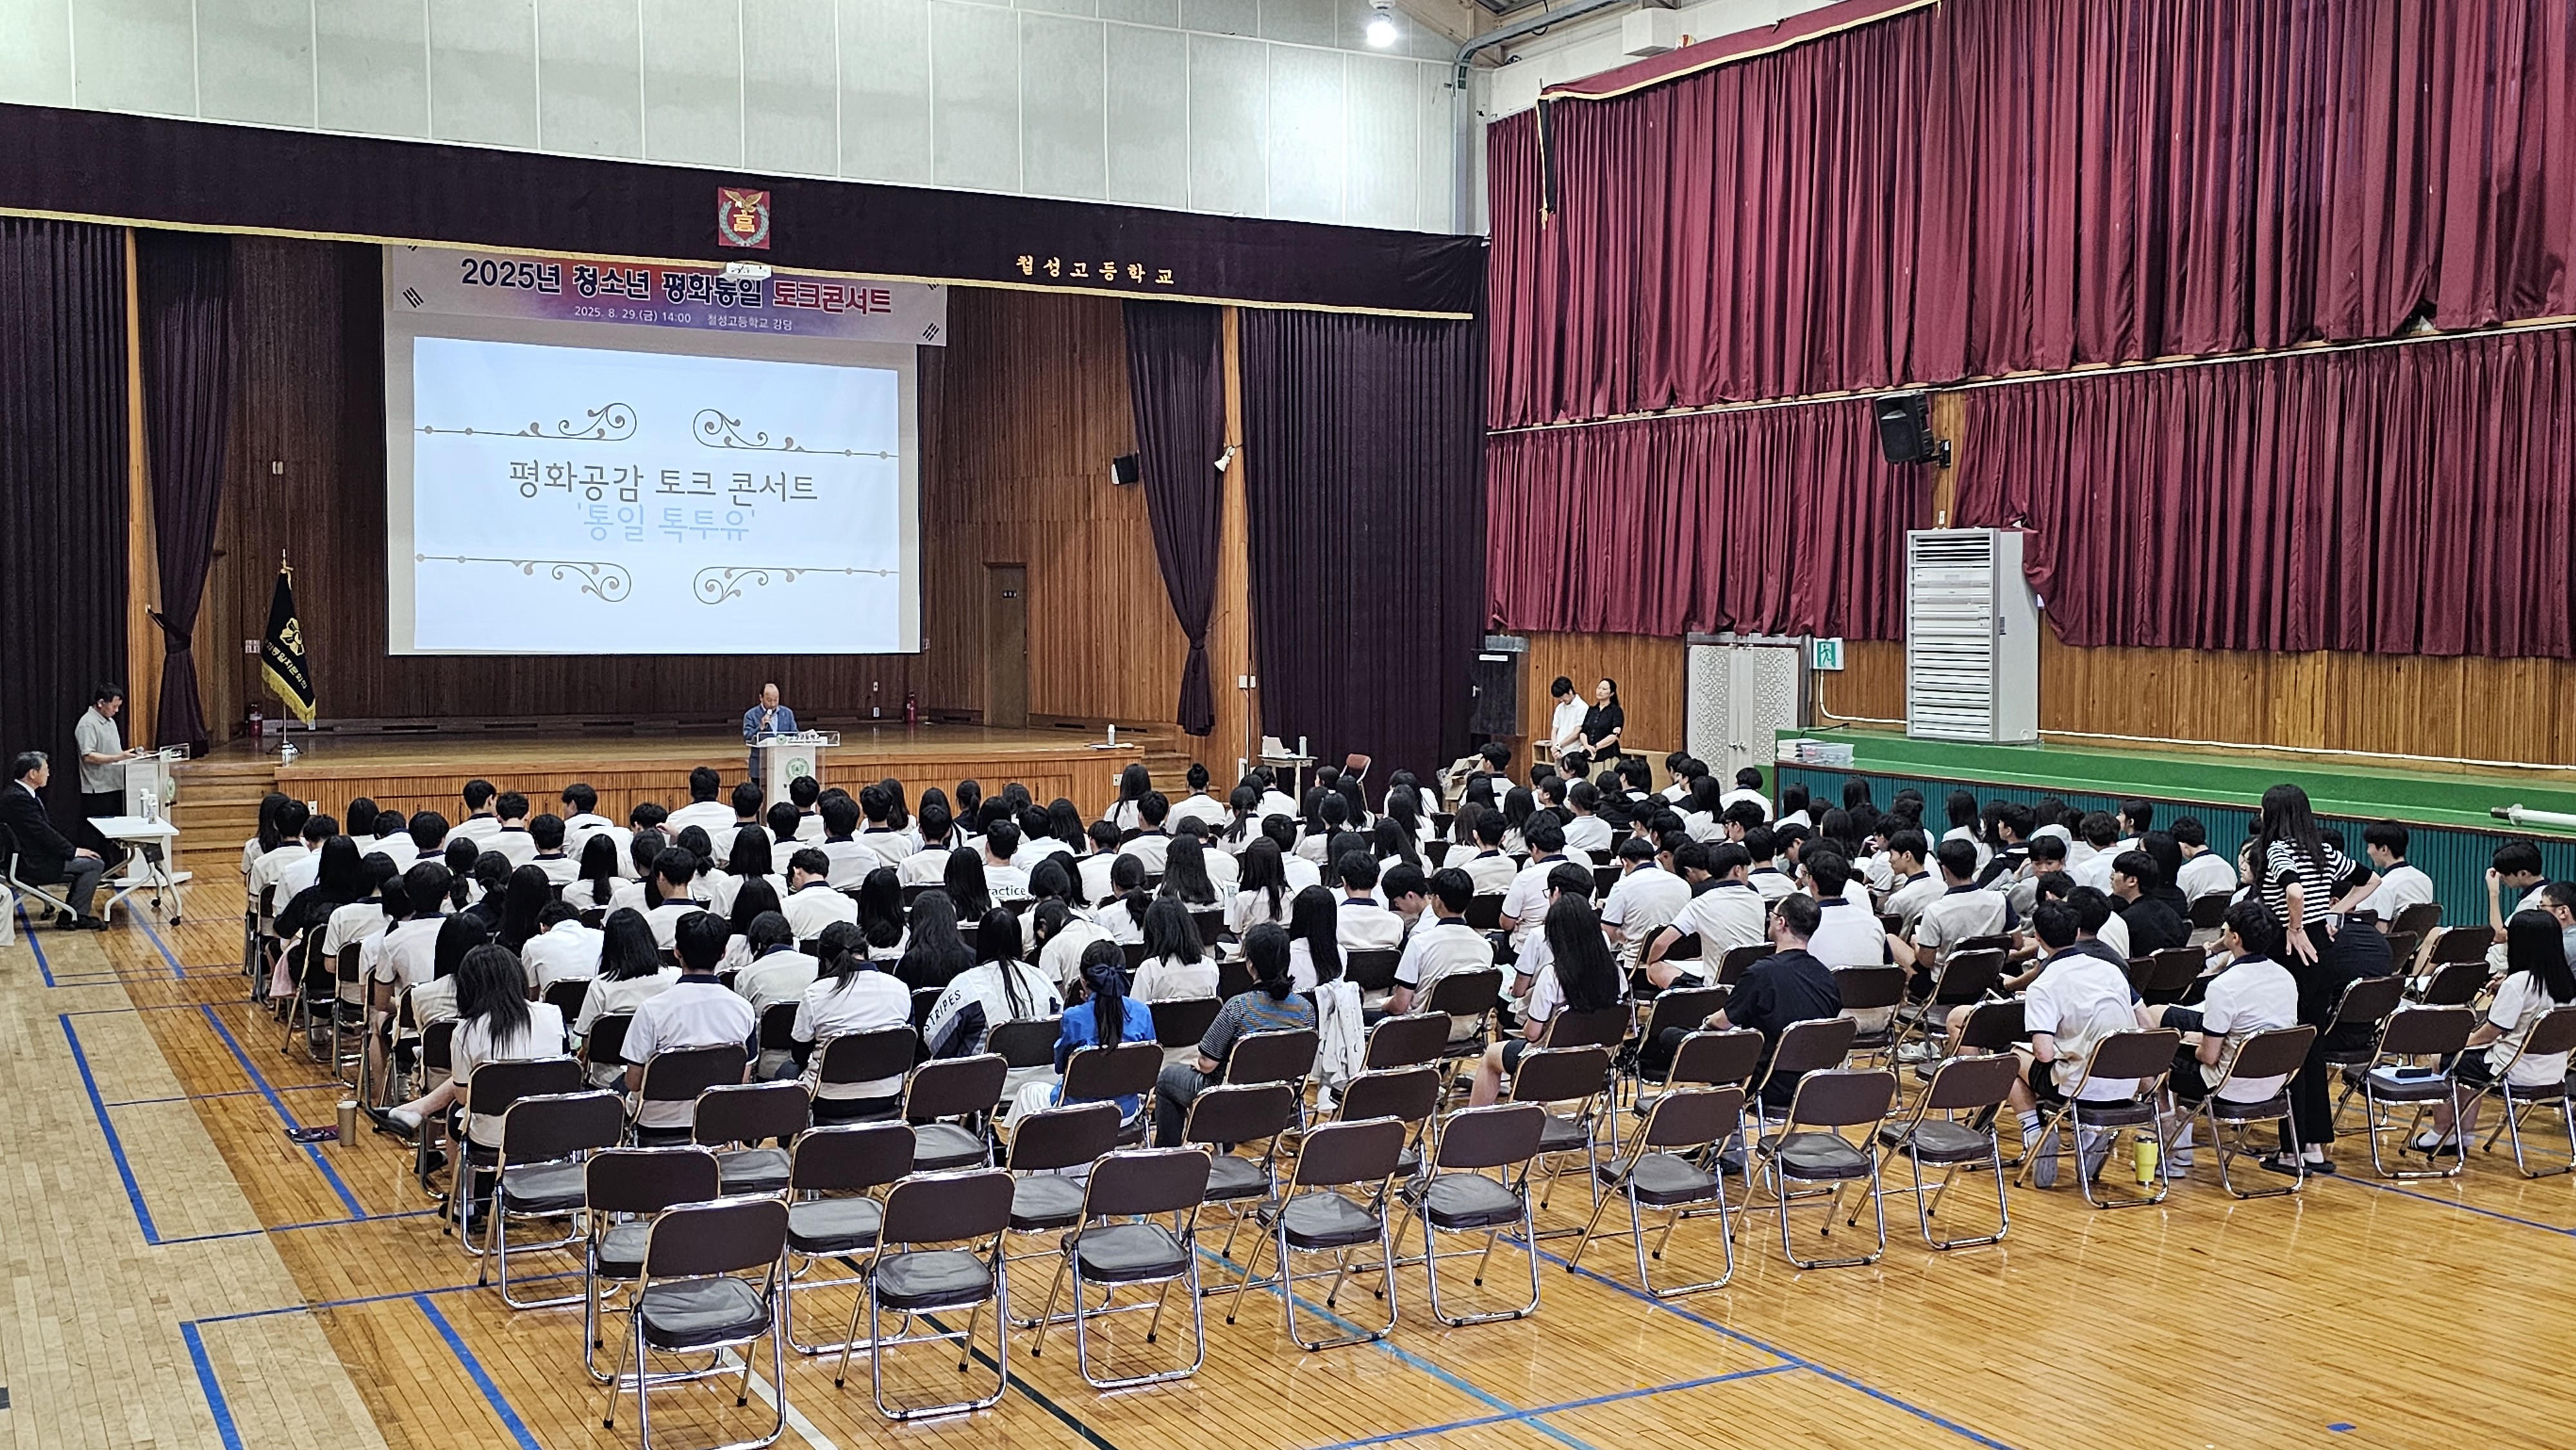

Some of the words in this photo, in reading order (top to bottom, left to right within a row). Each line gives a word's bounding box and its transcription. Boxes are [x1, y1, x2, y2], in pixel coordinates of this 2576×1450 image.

[460, 258, 562, 294] 2025년
[573, 265, 650, 300] 청소년
[661, 272, 762, 308] 평화통일
[773, 279, 891, 315] 토크콘서트
[574, 306, 604, 317] 2025.
[608, 308, 618, 318] 8.
[662, 312, 691, 323] 14:00
[773, 319, 792, 330] 강당
[509, 460, 644, 503] 평화공감
[656, 470, 717, 496] 토크
[728, 471, 818, 507] 콘서트
